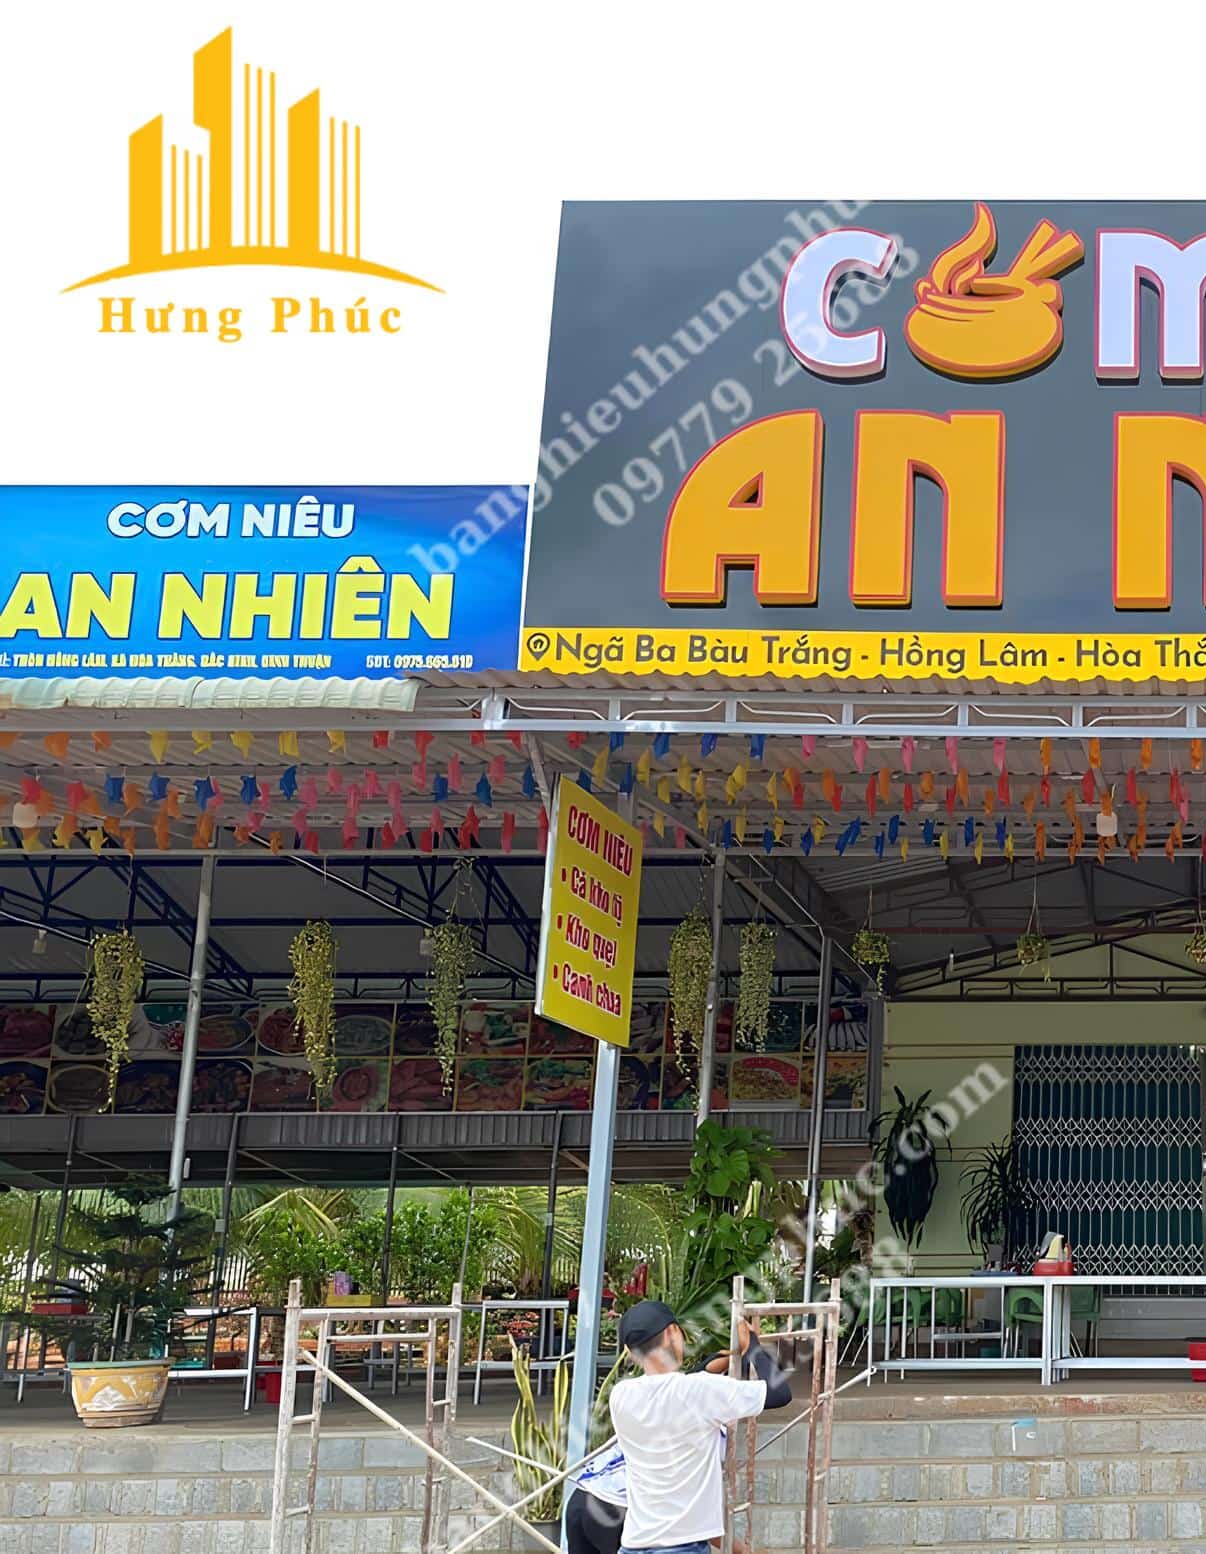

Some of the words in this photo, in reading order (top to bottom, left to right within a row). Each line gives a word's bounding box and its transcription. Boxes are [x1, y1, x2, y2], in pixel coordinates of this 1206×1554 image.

[106, 499, 229, 538] CƠM
[241, 496, 355, 537] NIÊU
[661, 408, 1004, 608] AN
[0, 573, 136, 639] AN
[158, 555, 456, 639] NHIÊN
[555, 634, 624, 668] Ngã
[636, 635, 676, 662] Ba
[688, 635, 748, 662] Bàu
[762, 633, 851, 671] Trắng
[881, 635, 966, 673] Hồng
[980, 639, 1048, 667] Lâm
[1076, 640, 1142, 667] Hòa
[567, 805, 600, 855] CƠM
[570, 866, 587, 900] Cá
[565, 913, 591, 952] Kho
[561, 963, 594, 1003] Canh
